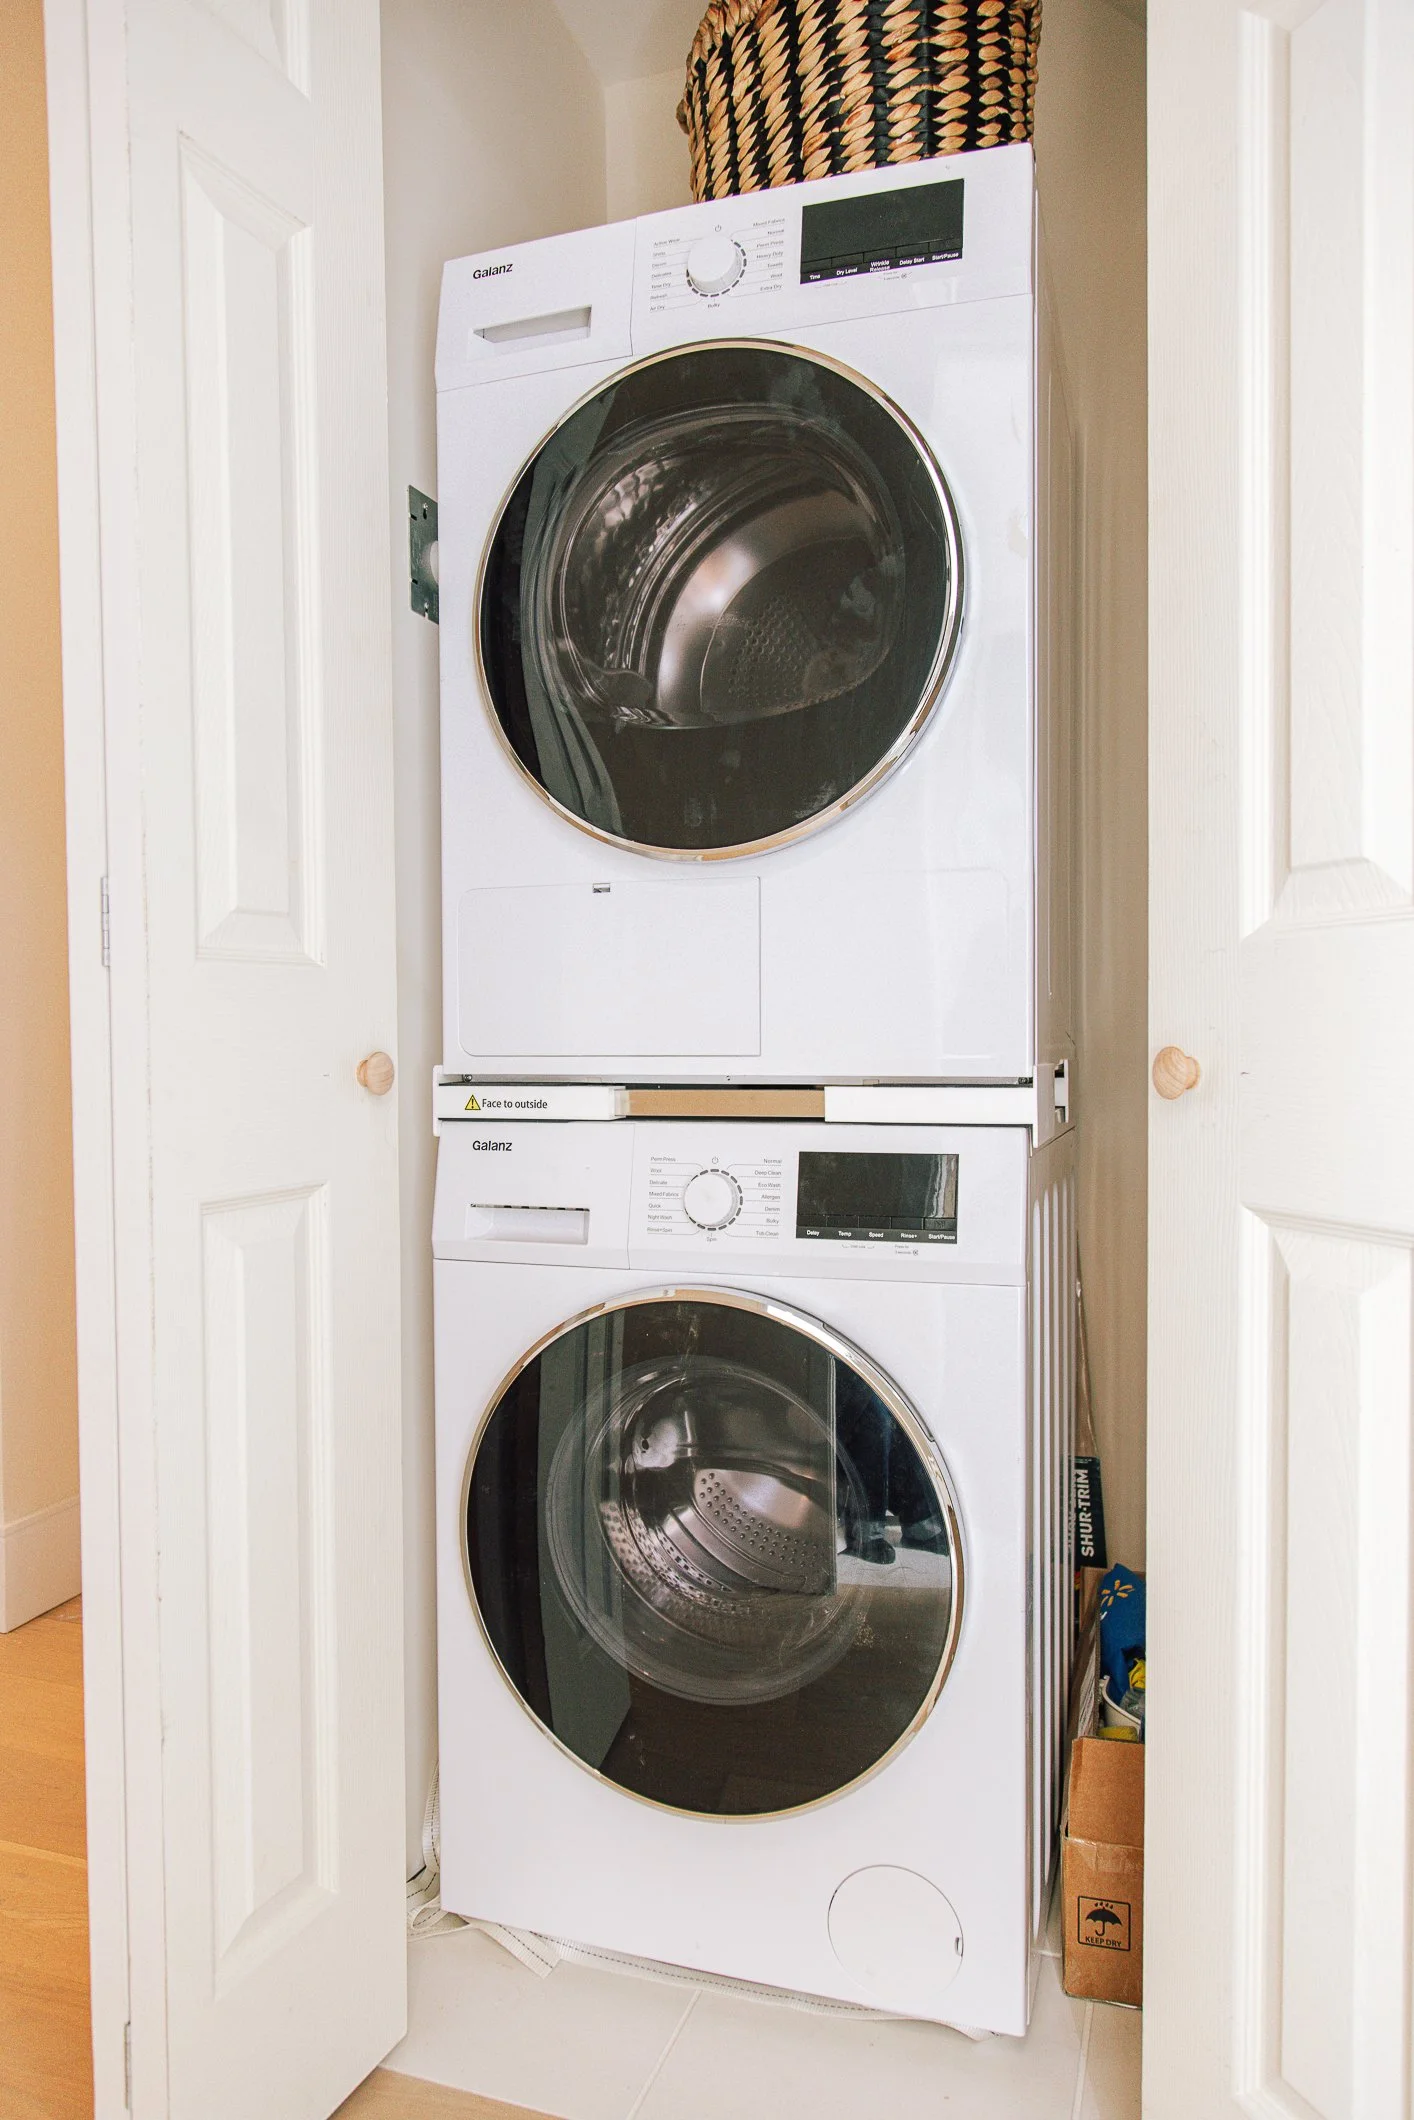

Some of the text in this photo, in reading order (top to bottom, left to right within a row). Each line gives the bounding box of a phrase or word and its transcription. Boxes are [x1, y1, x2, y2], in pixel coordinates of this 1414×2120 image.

[932, 252, 960, 261] Start/Pause
[473, 264, 513, 279] Galanz
[482, 1099, 548, 1109] Face to outside
[472, 1141, 512, 1152] Galanz
[1085, 1936, 1122, 1947] KEEP DRY
